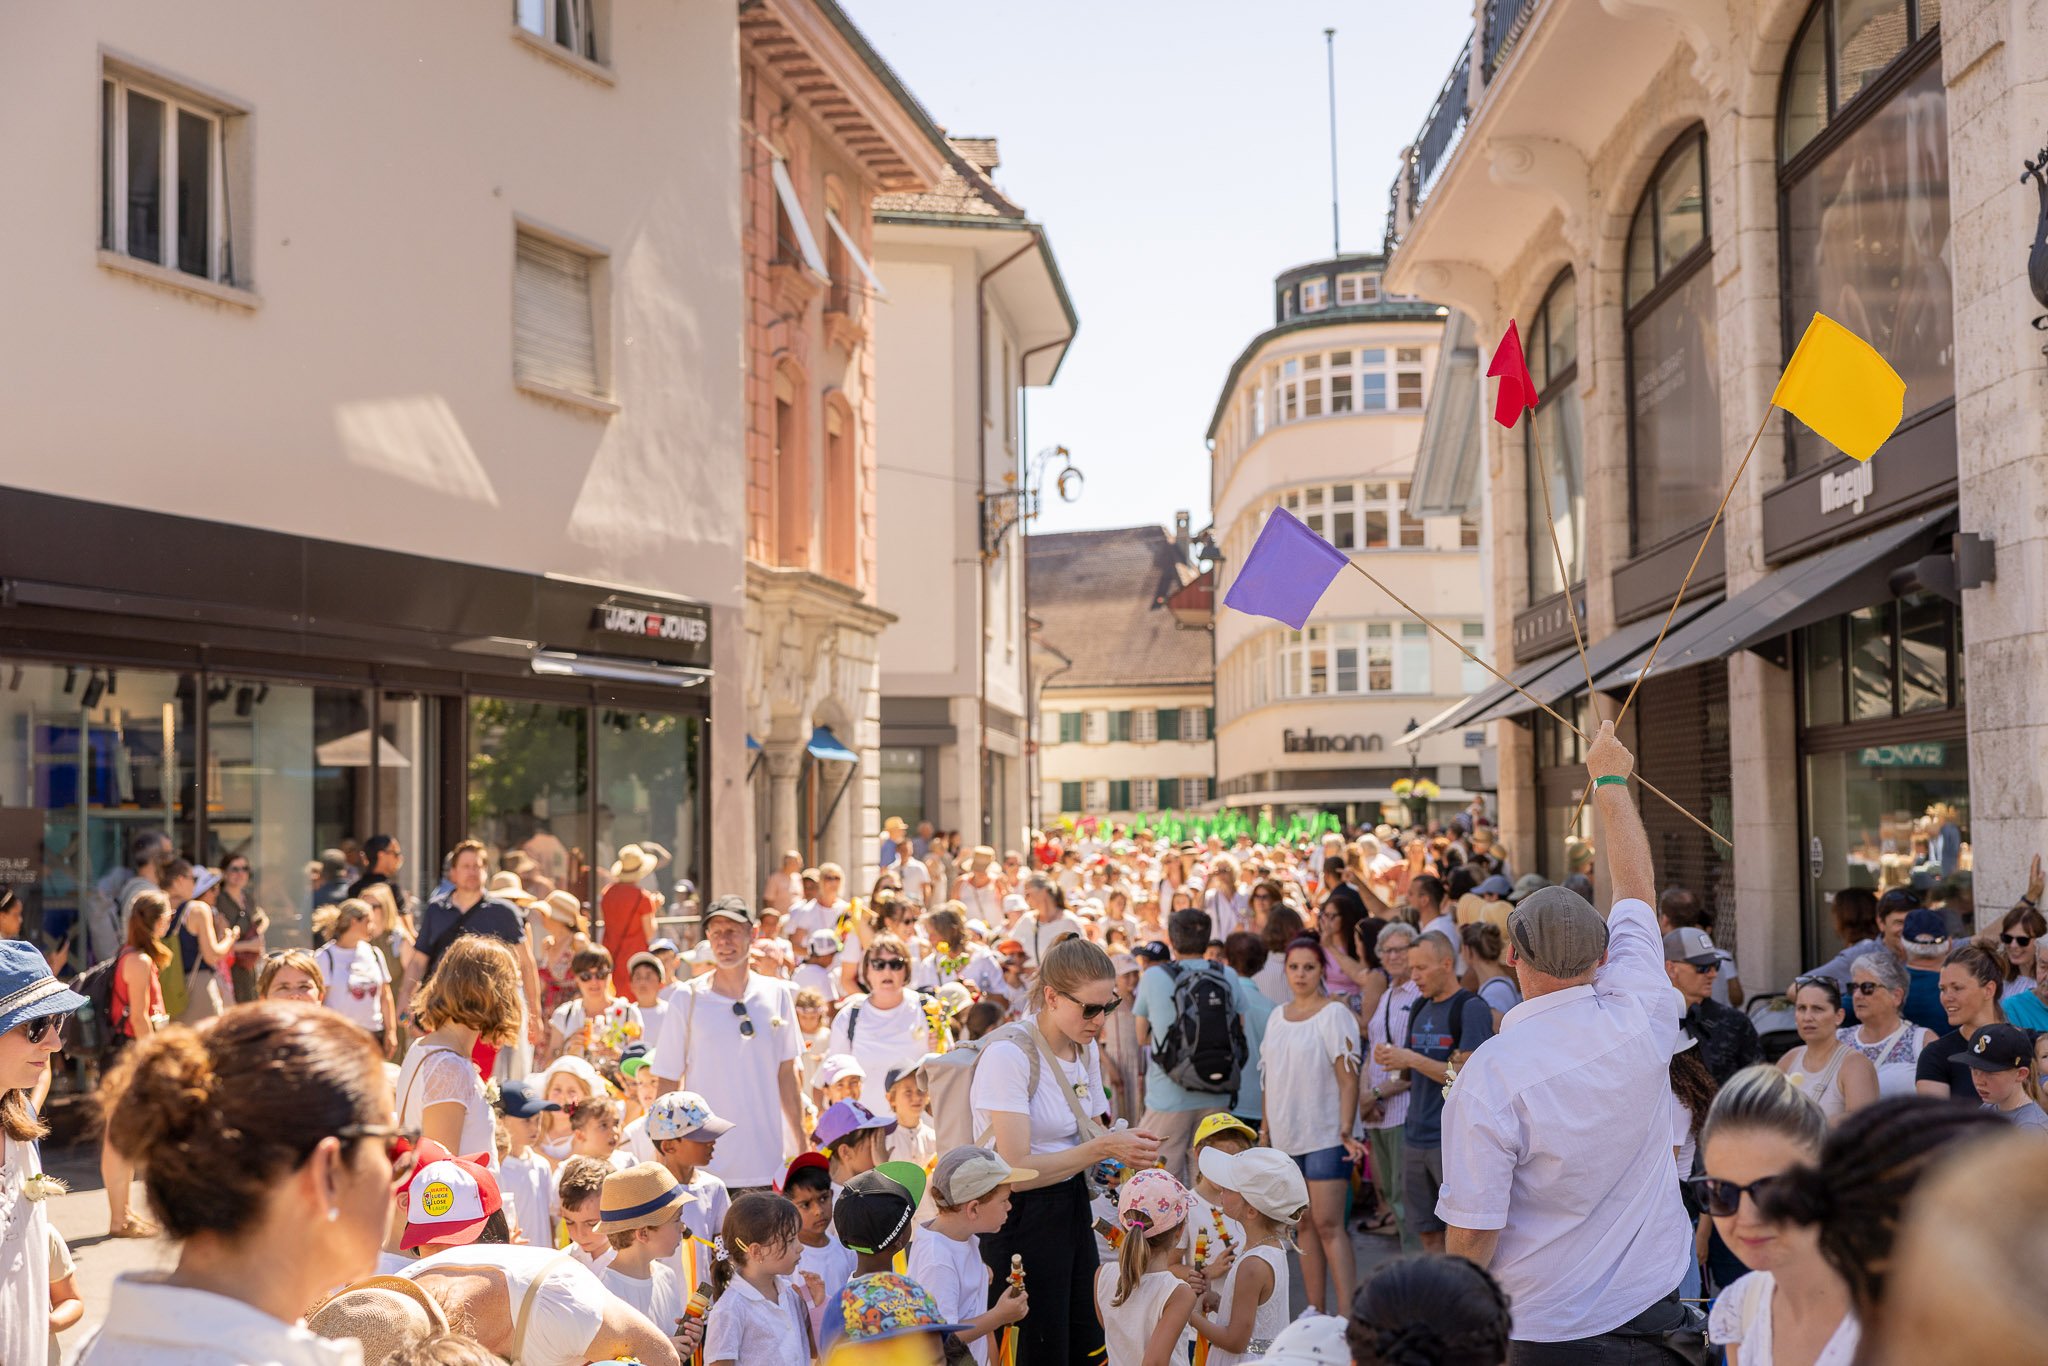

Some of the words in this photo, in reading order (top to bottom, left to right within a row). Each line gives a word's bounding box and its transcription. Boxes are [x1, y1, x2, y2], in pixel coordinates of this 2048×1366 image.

[605, 607, 647, 634] JACK
[660, 614, 707, 642] JONES
[878, 1204, 911, 1250] MINECRAFT
